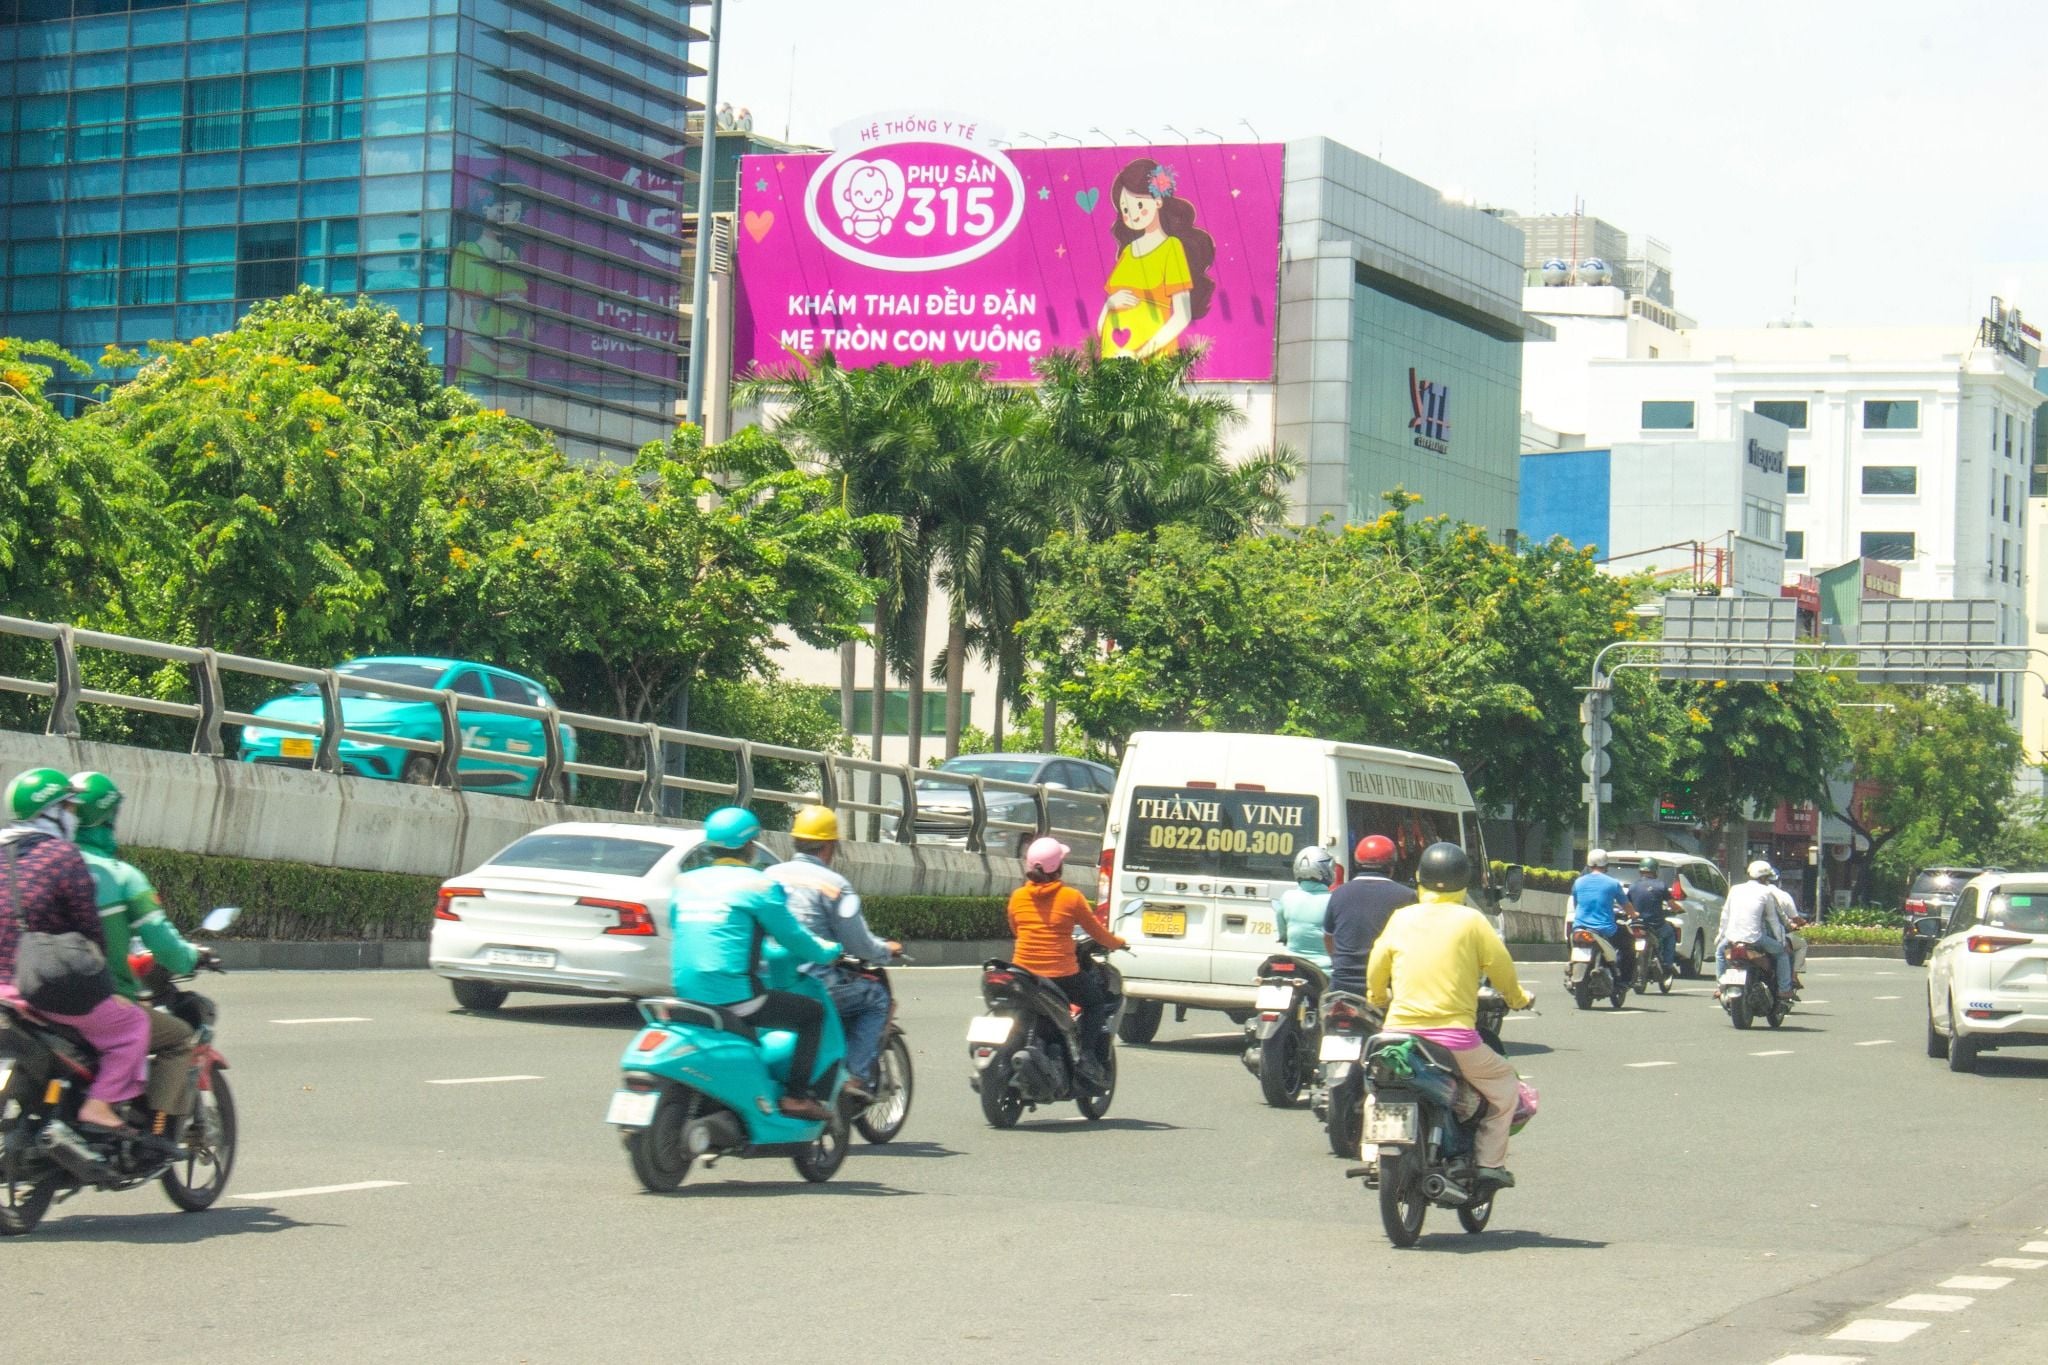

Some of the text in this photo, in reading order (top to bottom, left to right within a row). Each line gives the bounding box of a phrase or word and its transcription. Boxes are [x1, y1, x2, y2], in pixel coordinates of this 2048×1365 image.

[860, 114, 978, 142] HỆ THỐNG Y TẾ
[907, 159, 997, 187] PHỤ SẢN
[904, 186, 995, 237] 315
[788, 285, 1036, 320] KHÁM THAI ĐỀU ĐẶN
[780, 323, 1042, 357] MẸ TRÒN CON VUÔNG
[1346, 764, 1384, 795] THÀNH
[1385, 776, 1409, 799] VINH
[1137, 793, 1304, 827] THÀNH VINH
[1149, 825, 1294, 856] 0822.600.300
